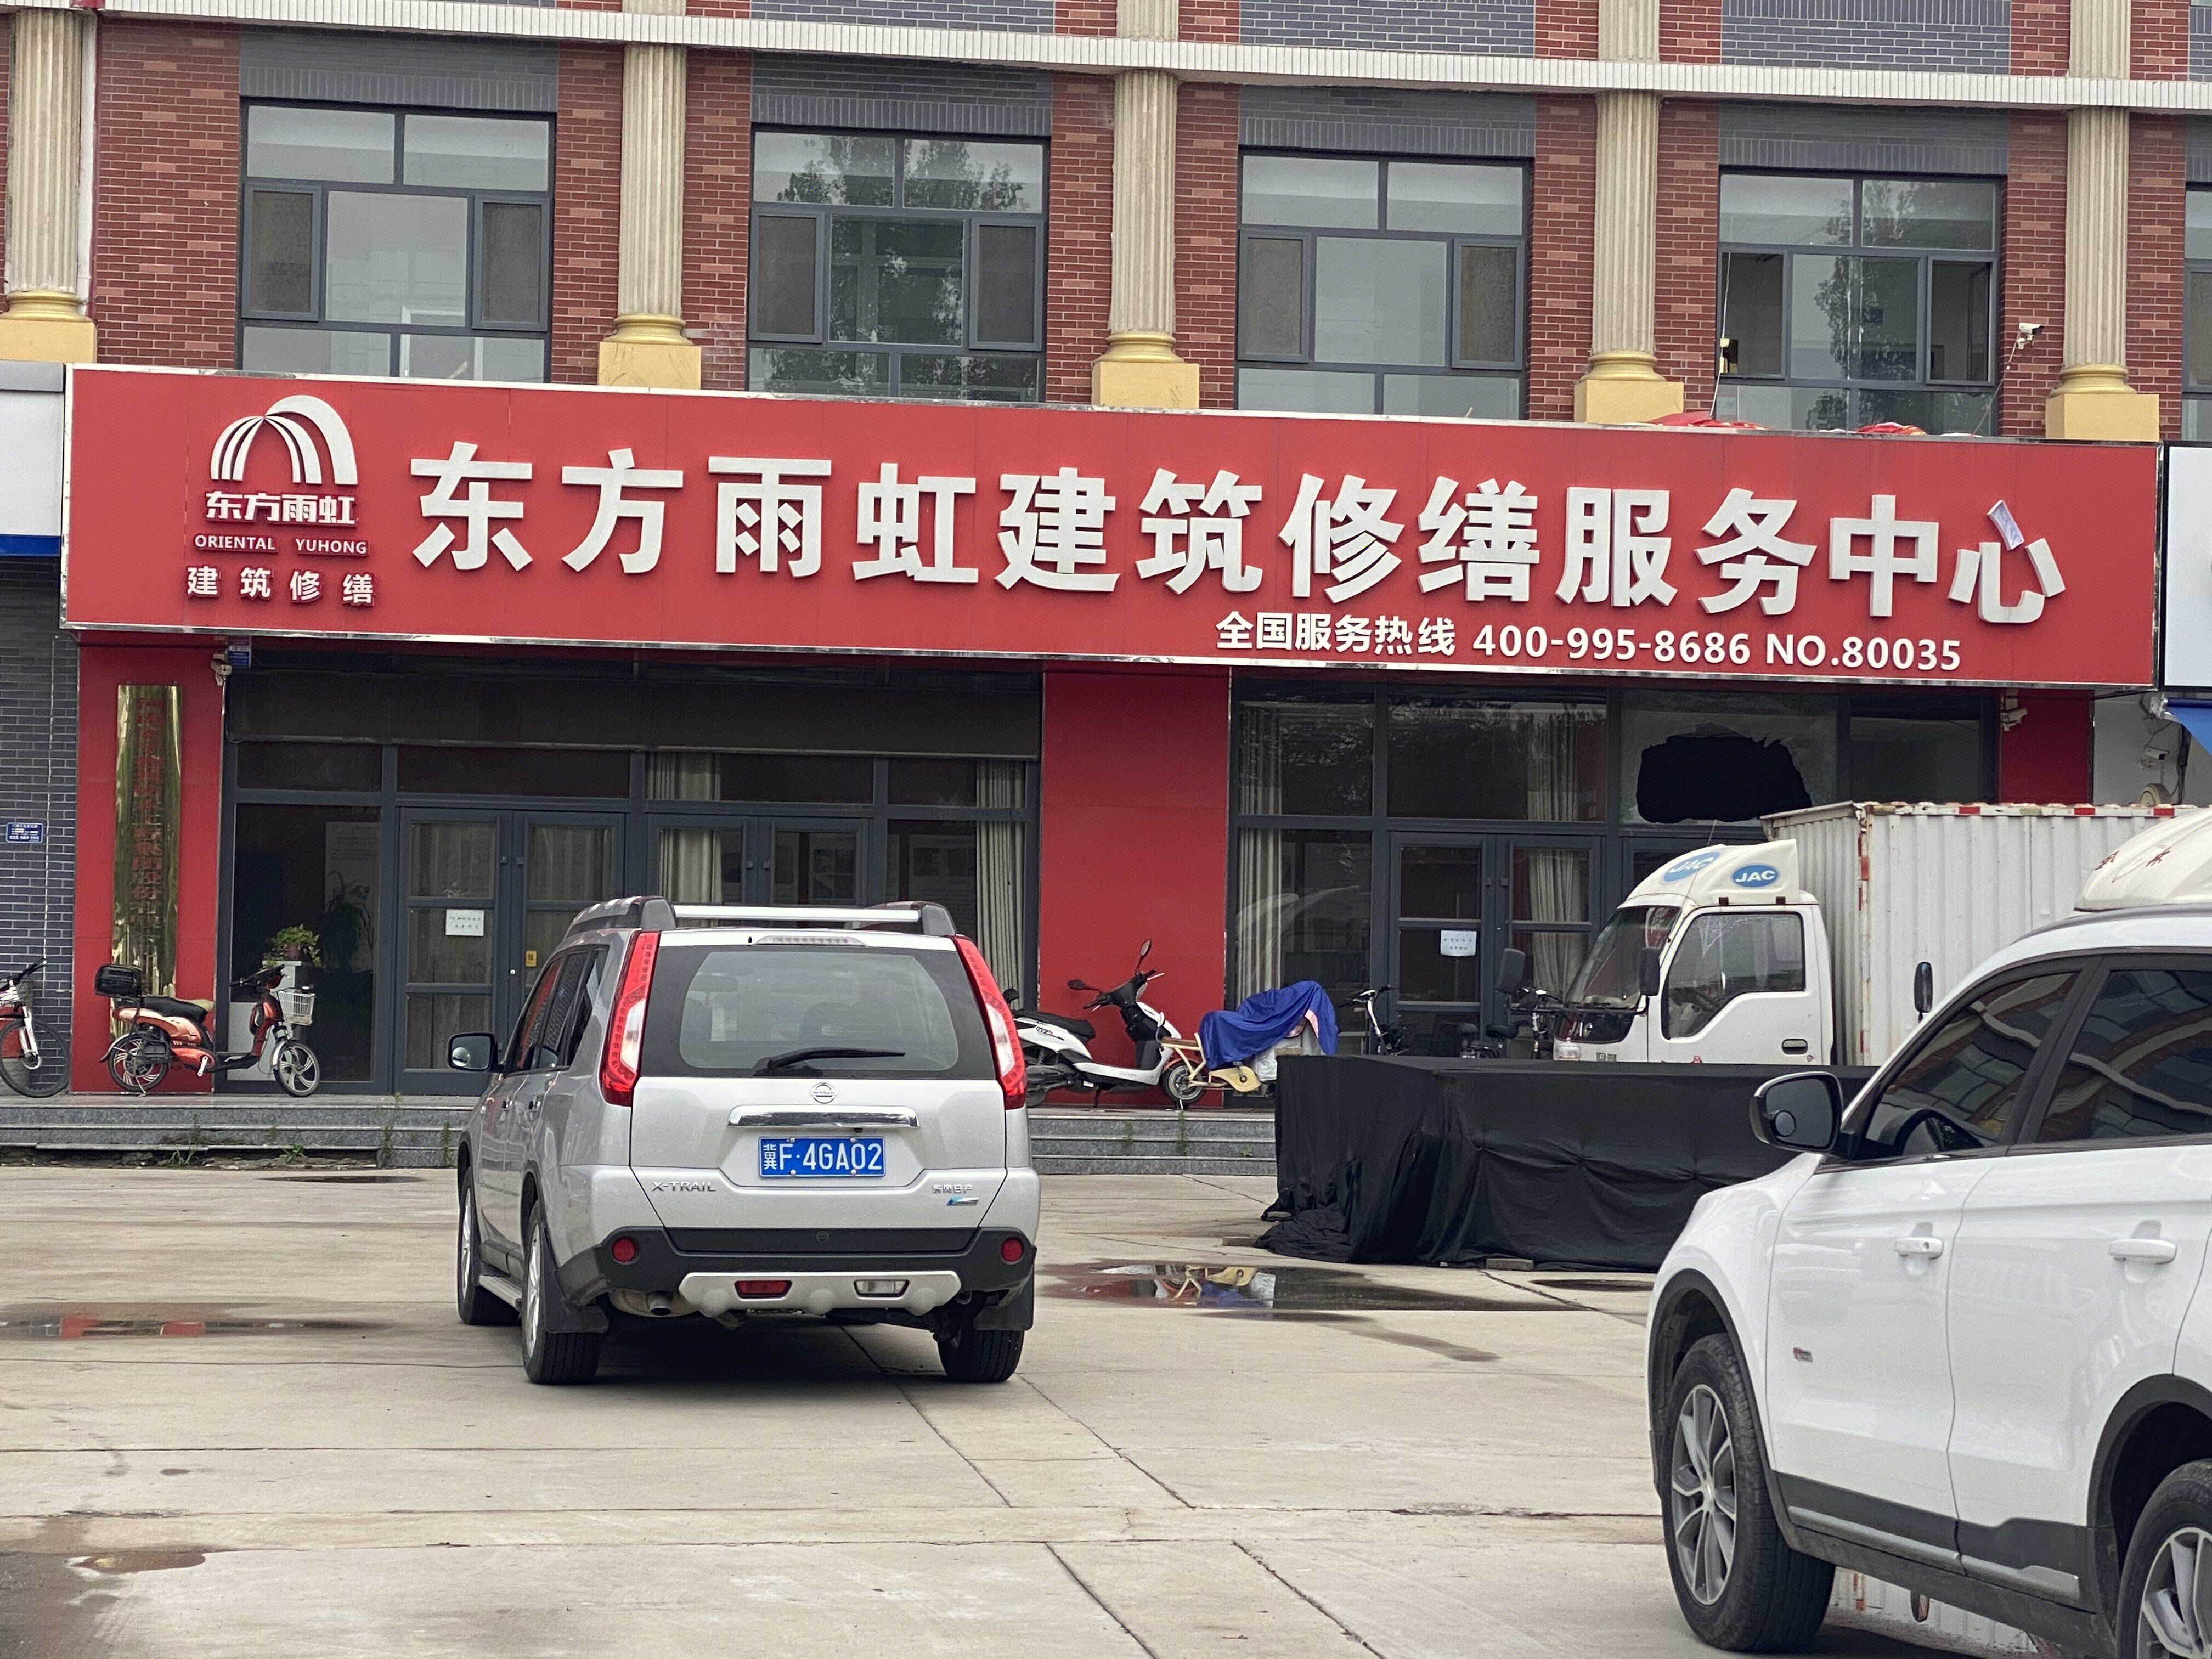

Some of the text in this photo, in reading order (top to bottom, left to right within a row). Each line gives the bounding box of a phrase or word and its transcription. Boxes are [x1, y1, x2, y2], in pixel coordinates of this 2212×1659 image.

[206, 491, 356, 525] 东方雨虹
[411, 441, 2066, 624] 东方雨虹建筑修缮服务中心
[194, 535, 367, 555] ORIENTAL YUHONG
[187, 566, 374, 605] 建筑修缮
[1216, 611, 1961, 671] 全国服务热线 400-995-8686 NO.80035
[1668, 857, 1714, 873] JAC
[1735, 870, 1776, 883] JAC
[652, 1181, 716, 1192] X-TRAIL
[932, 1184, 973, 1194] 东风日产
